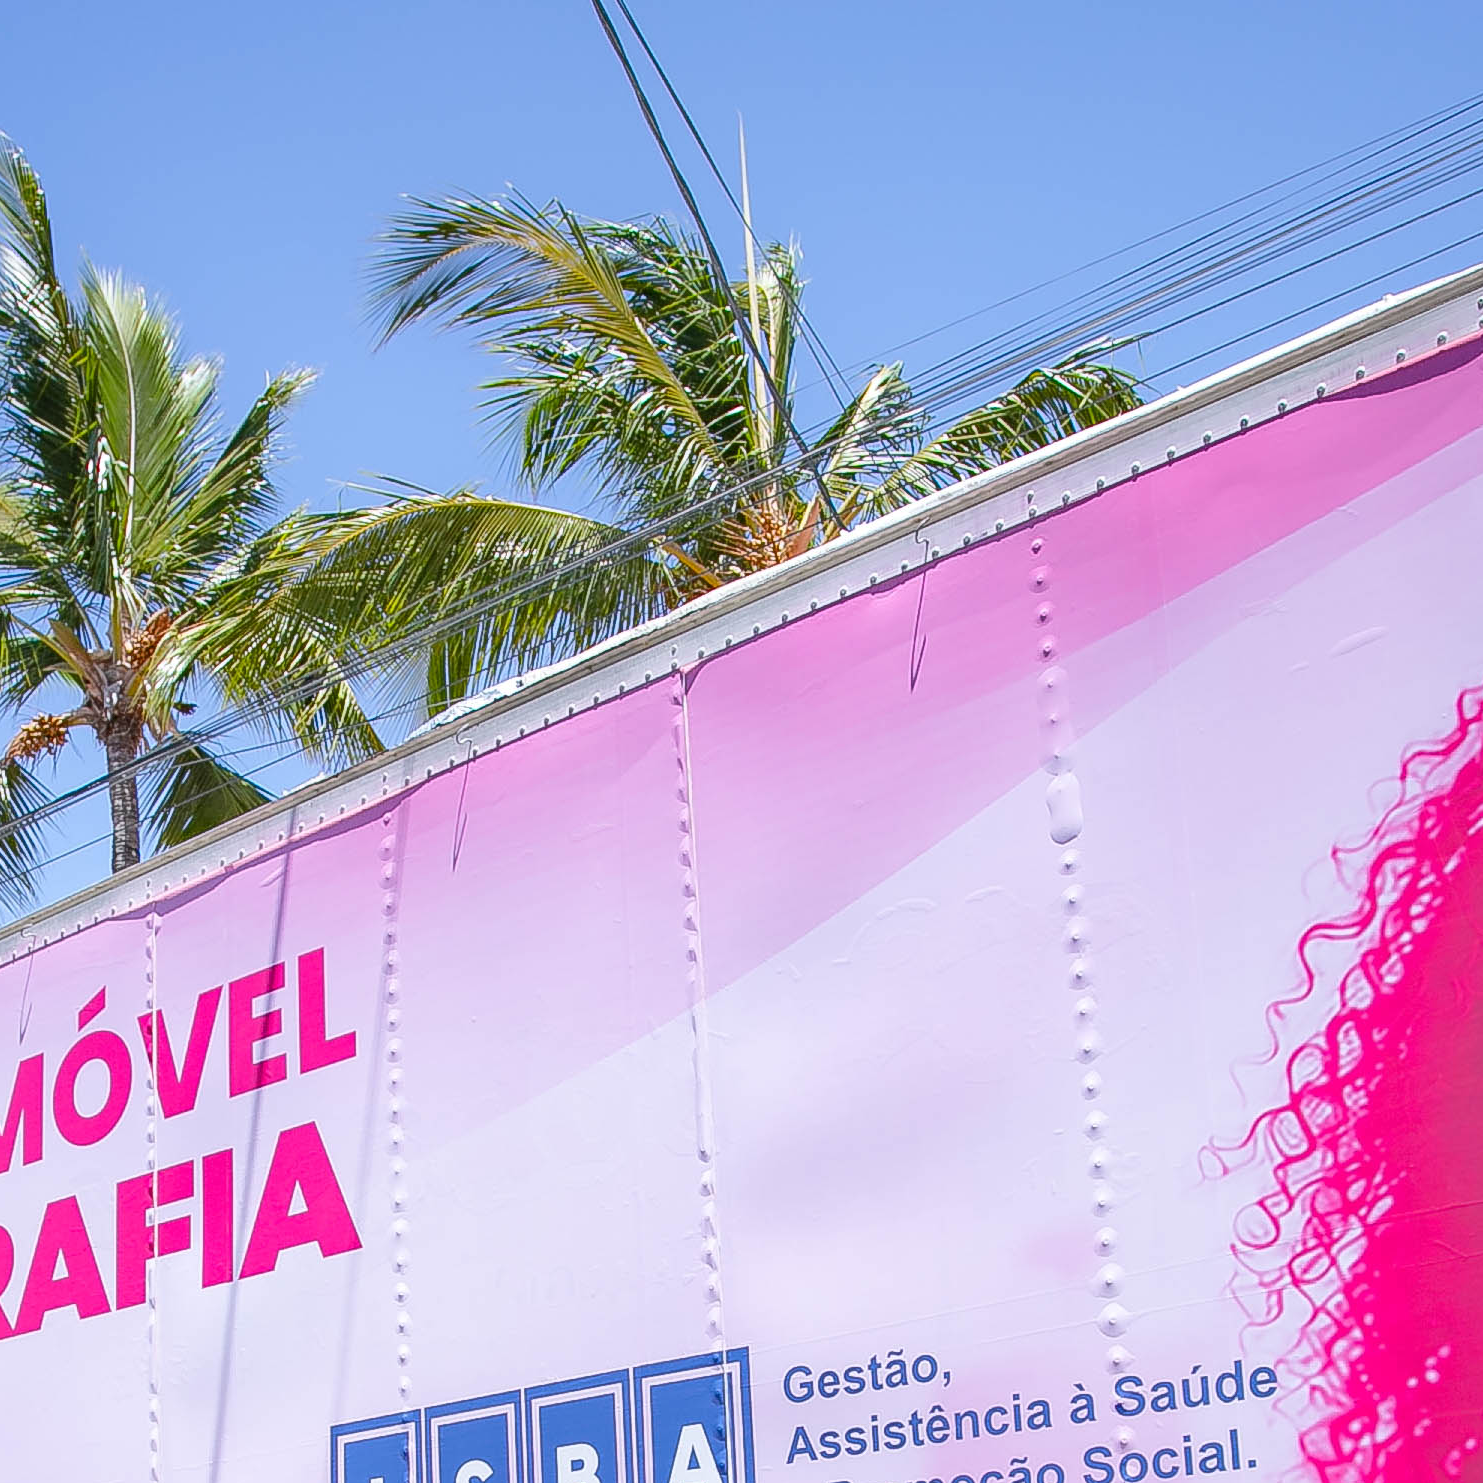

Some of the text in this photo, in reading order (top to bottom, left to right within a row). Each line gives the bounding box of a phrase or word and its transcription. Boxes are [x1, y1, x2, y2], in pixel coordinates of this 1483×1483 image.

[783, 1349, 953, 1404] Gestão,
[786, 1359, 1279, 1465] Assistência à Saúde
